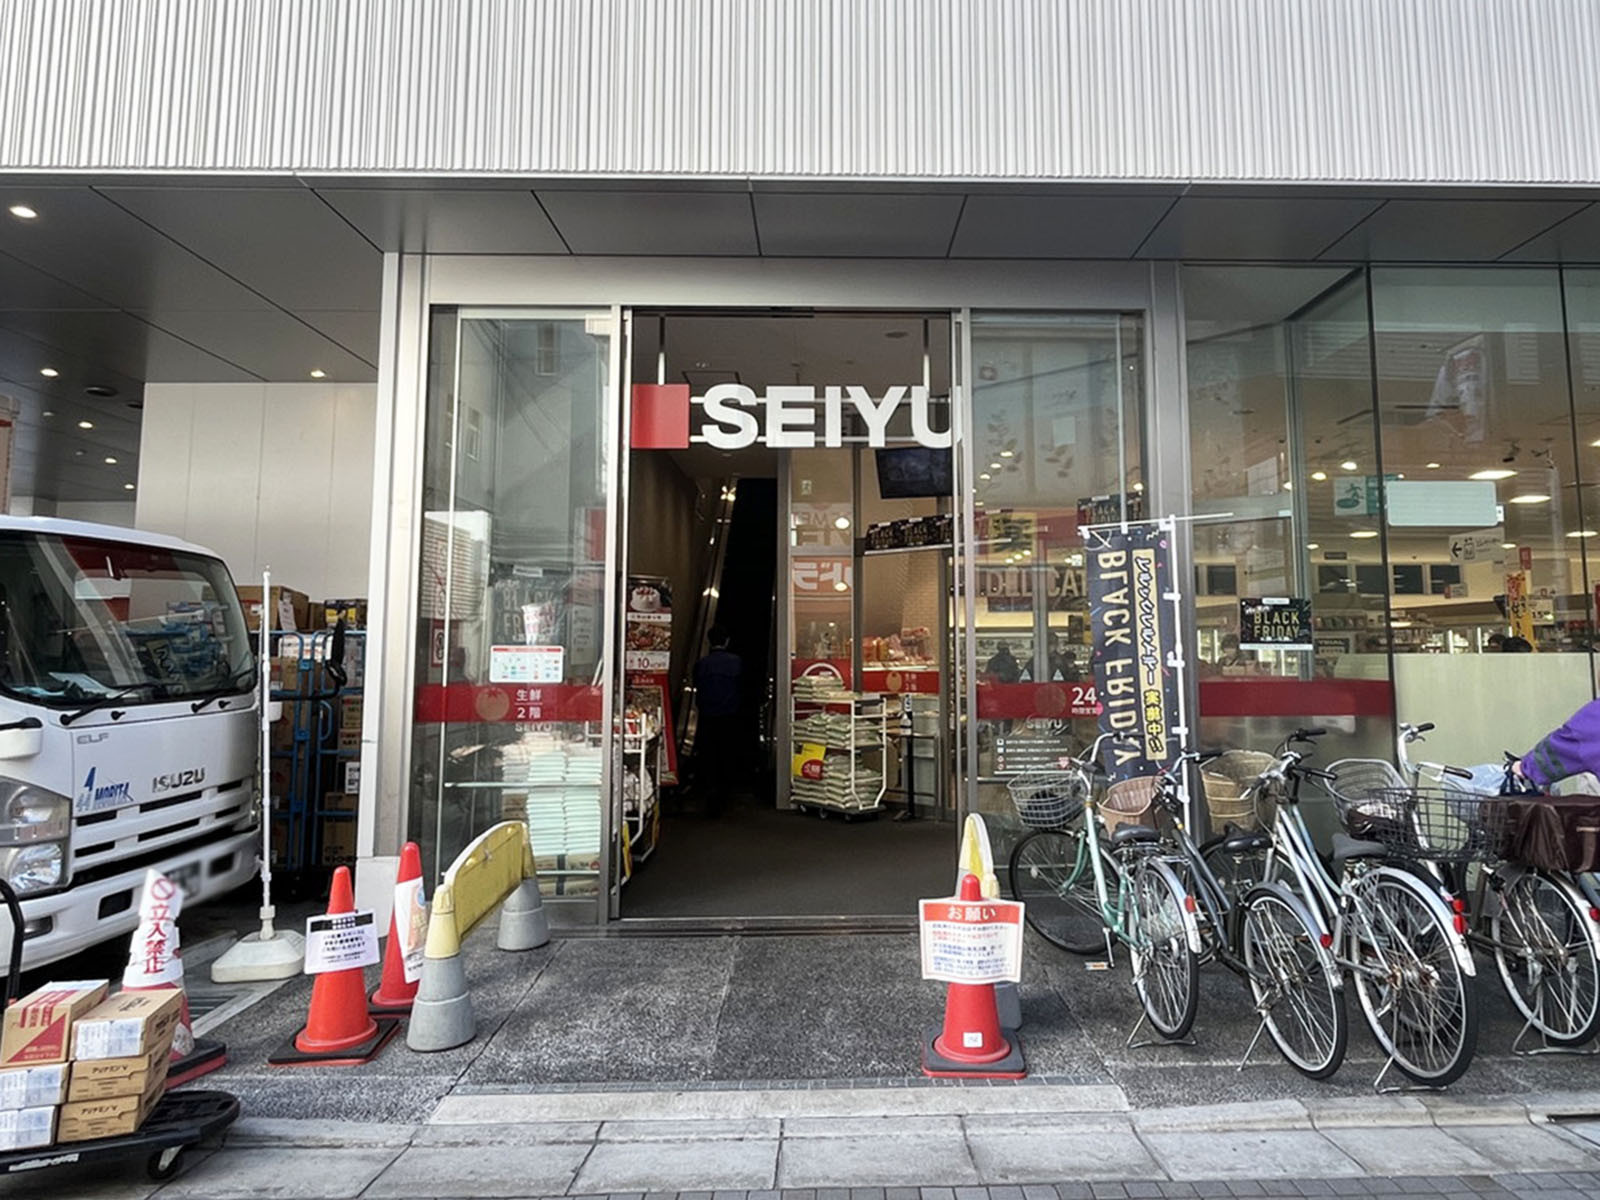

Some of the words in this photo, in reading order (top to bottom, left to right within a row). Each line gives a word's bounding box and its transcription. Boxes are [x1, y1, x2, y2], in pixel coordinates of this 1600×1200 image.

[701, 384, 963, 449] SEIYU
[1254, 612, 1299, 625] BLACK
[1254, 626, 1300, 638] FRIDAY
[1072, 686, 1097, 705] 24
[152, 768, 205, 793] ISUZU
[947, 906, 997, 921] お願い
[143, 904, 170, 974] 立入禁止
